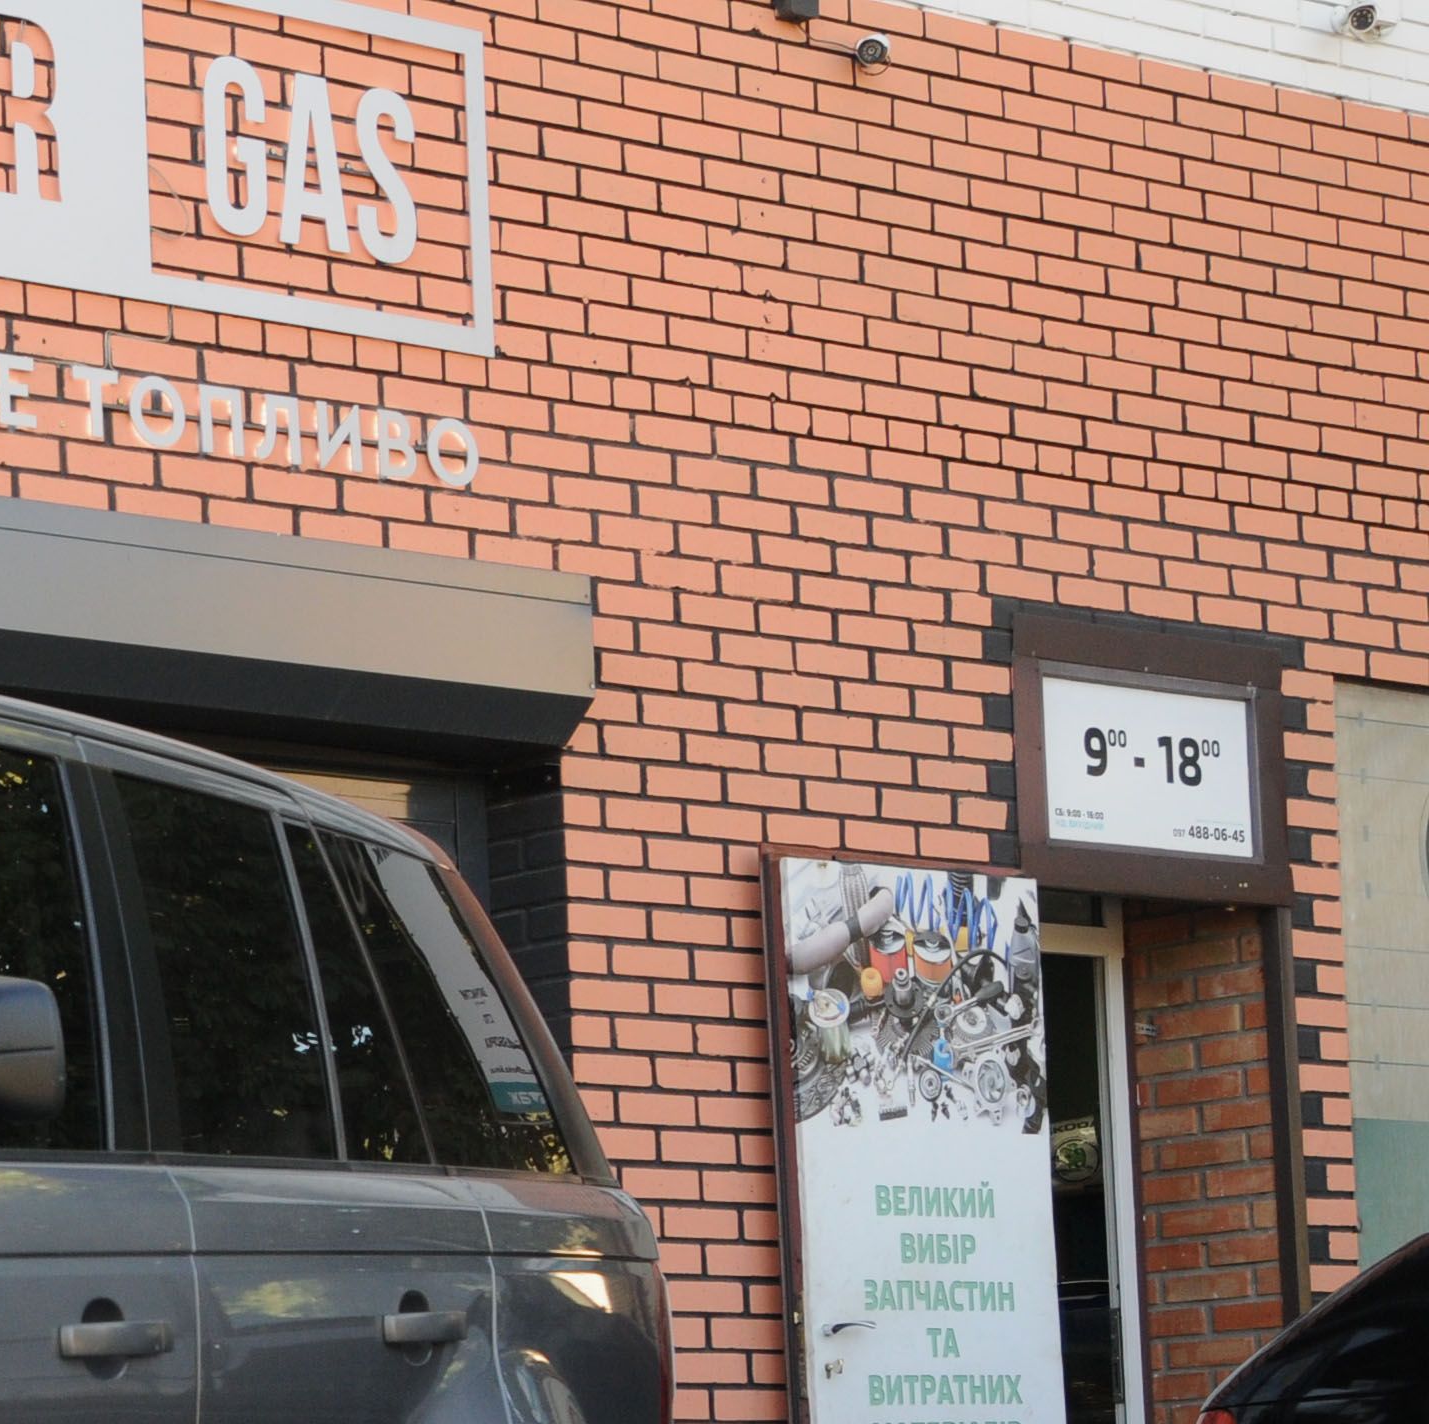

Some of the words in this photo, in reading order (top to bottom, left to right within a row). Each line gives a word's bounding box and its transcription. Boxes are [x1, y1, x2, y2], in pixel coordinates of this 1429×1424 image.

[203, 54, 416, 266] GAS
[72, 363, 479, 487] ТОПЛИВО
[1188, 825, 1245, 844] 488-06-45
[874, 1181, 995, 1219] ВЕЛИКИЙ
[899, 1232, 976, 1265] ВИБІР
[863, 1278, 1015, 1312] ЗАПЧАСТИН
[926, 1327, 960, 1359] ТА
[868, 1374, 1023, 1406] ВИТРАТНИХ
